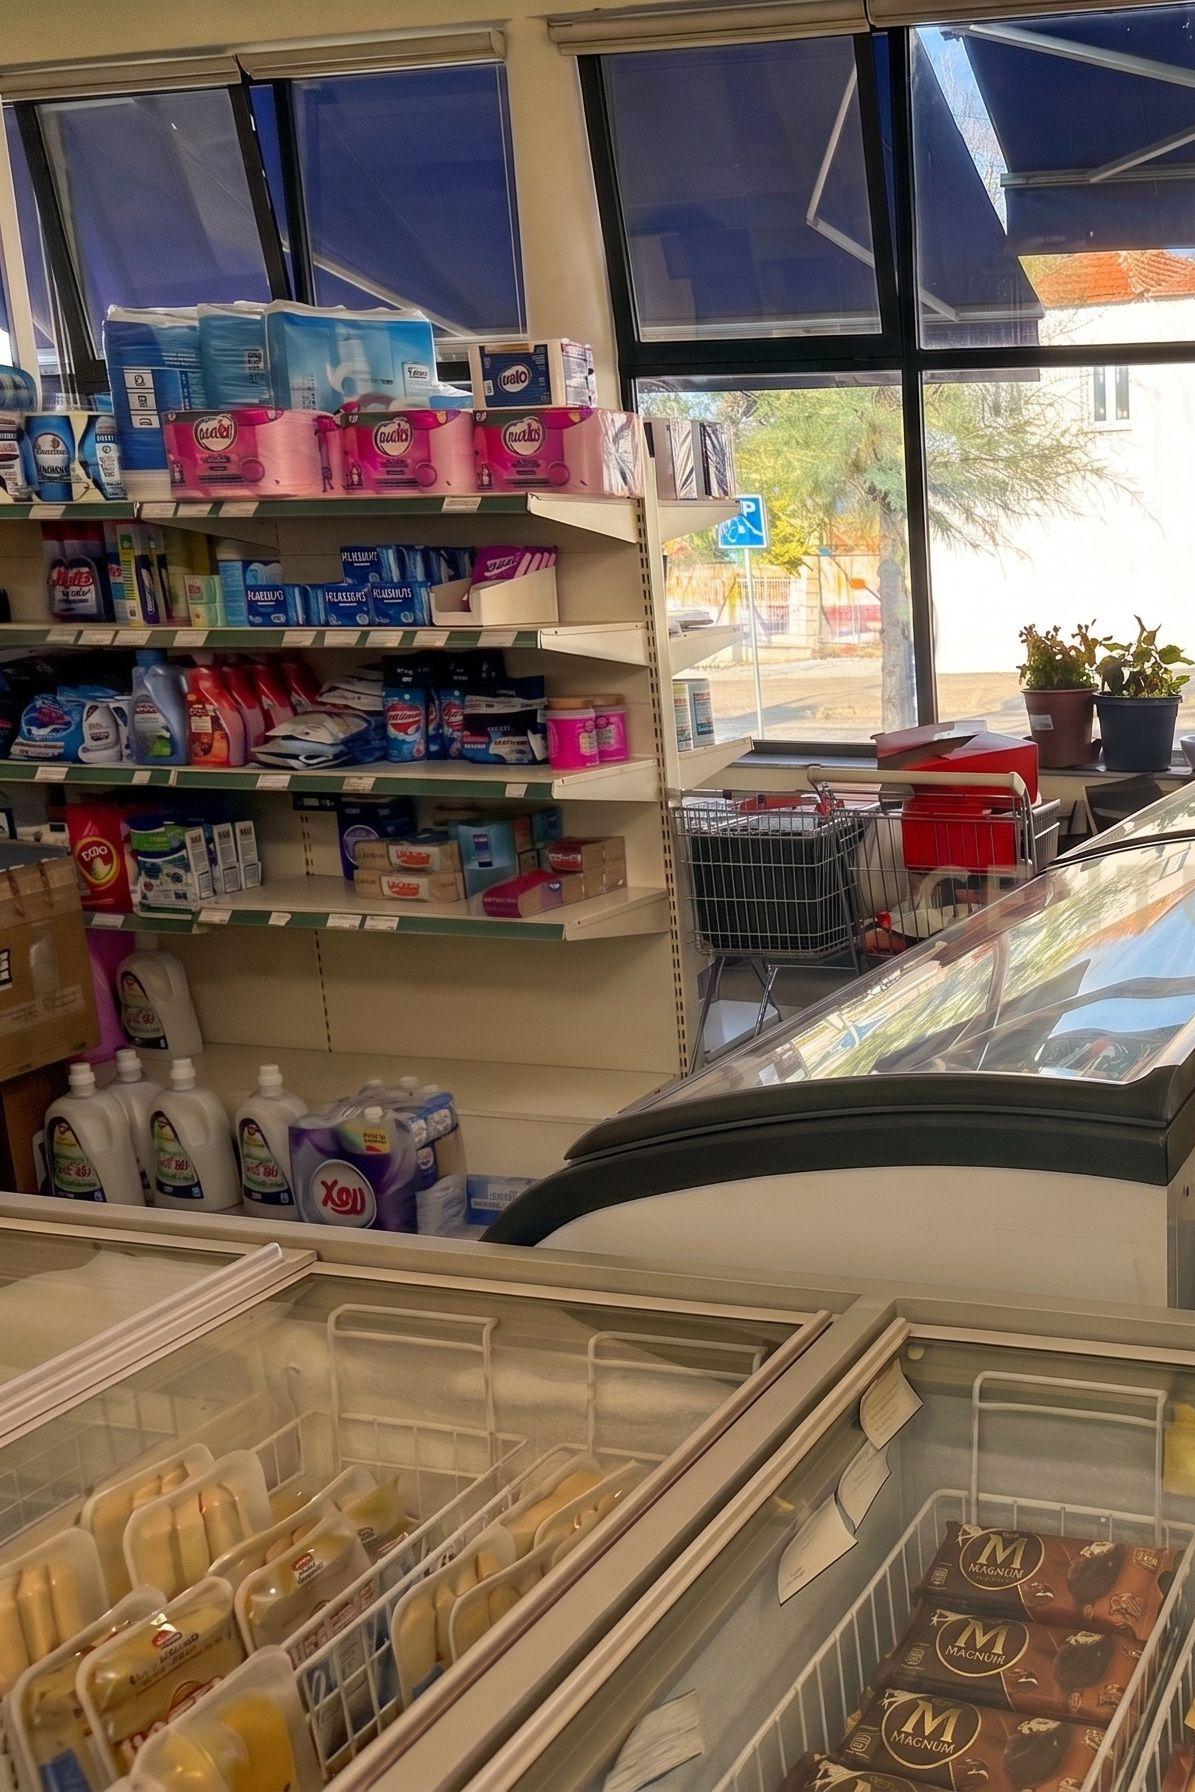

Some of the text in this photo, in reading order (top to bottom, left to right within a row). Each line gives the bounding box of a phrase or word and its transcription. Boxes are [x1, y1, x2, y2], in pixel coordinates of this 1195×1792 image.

[740, 500, 756, 517] P
[976, 1533, 1029, 1569] M
[968, 1563, 1024, 1579] MAGNUM
[954, 1618, 1010, 1654] M
[944, 1645, 1006, 1665] MAGNUM
[900, 1699, 963, 1743] M
[891, 1730, 956, 1754] MAGNUM
